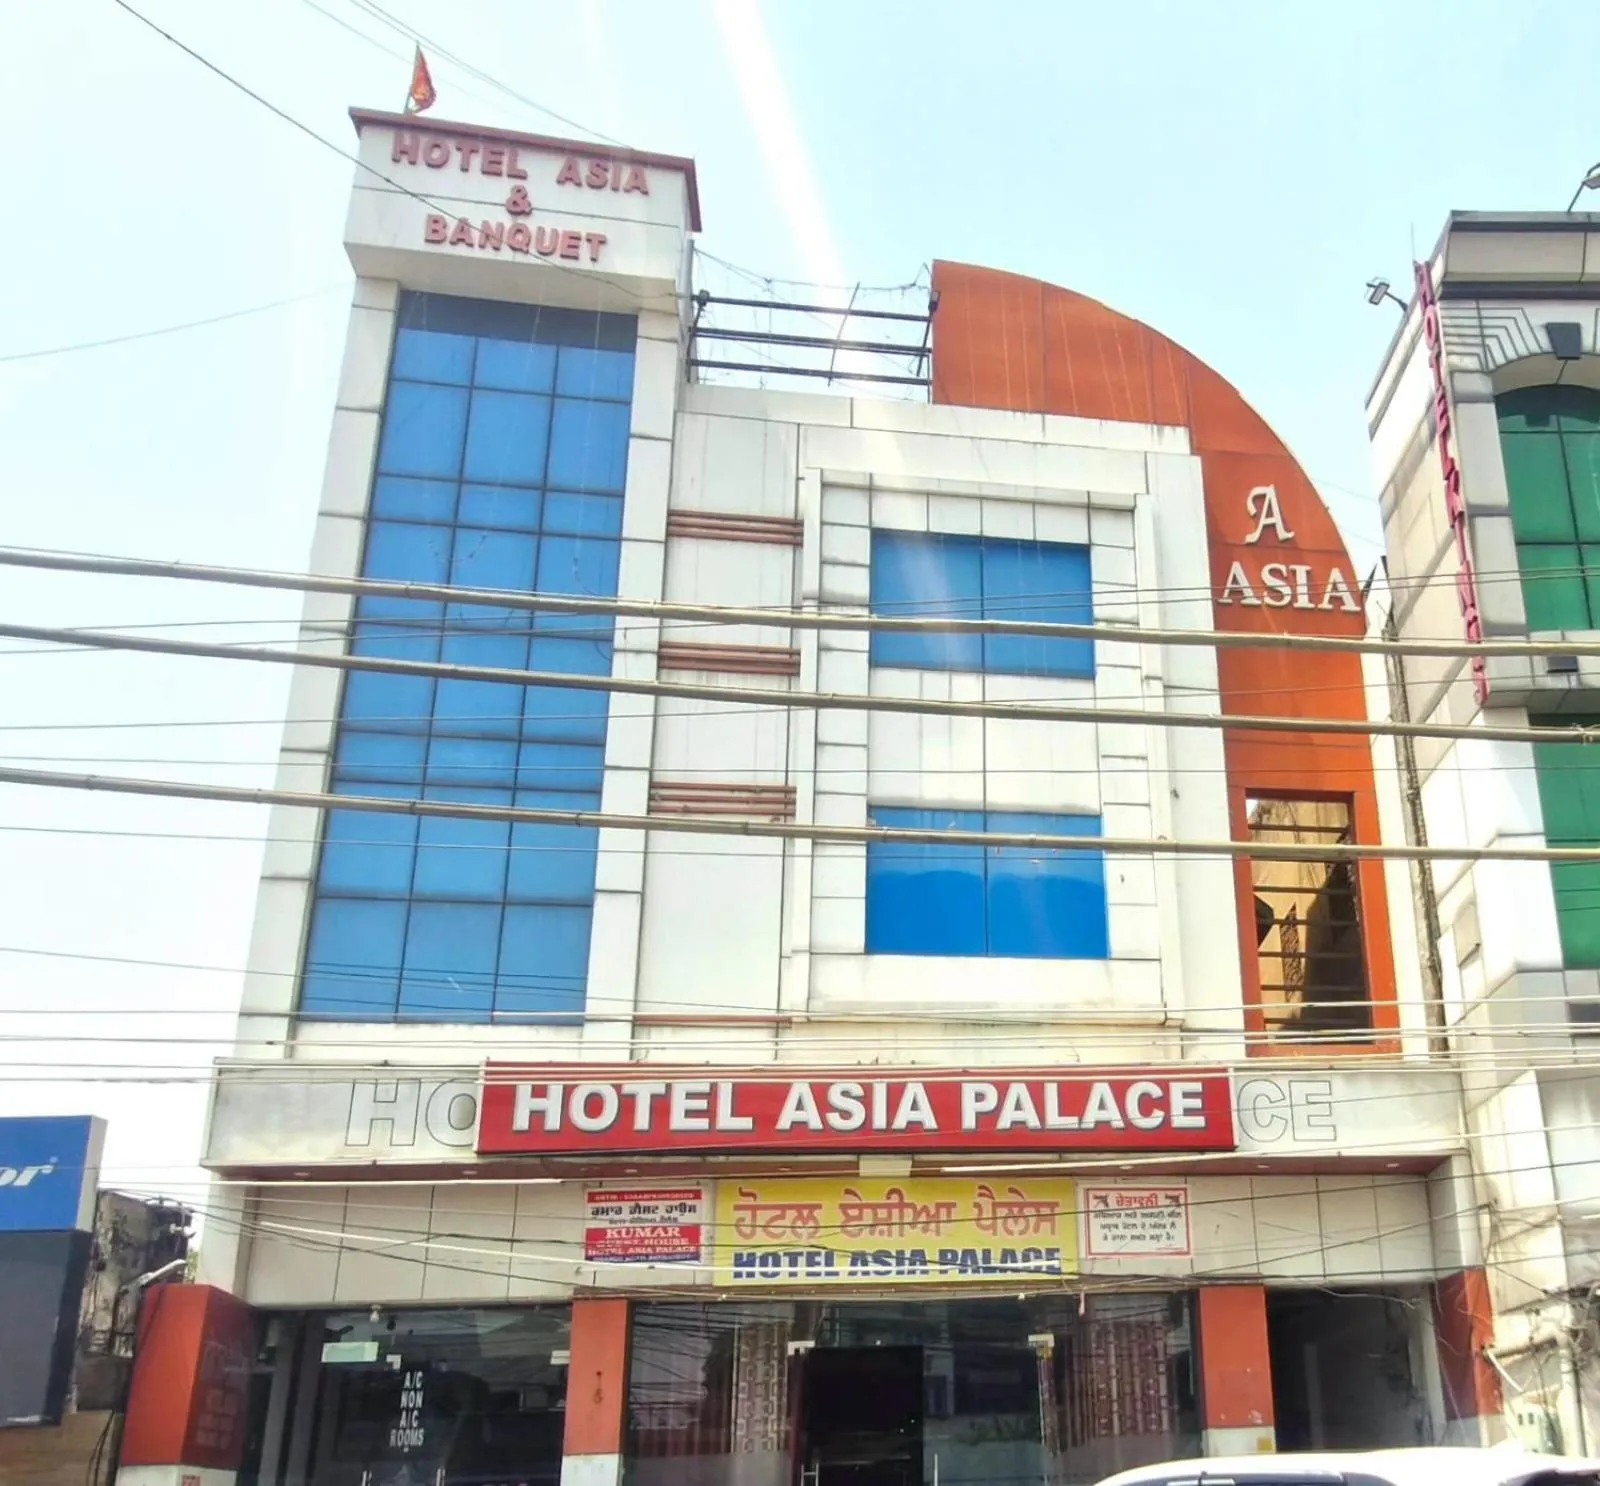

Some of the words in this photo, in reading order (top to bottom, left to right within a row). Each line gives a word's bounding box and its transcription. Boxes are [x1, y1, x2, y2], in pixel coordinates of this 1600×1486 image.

[391, 132, 528, 181] HOTEL
[556, 157, 650, 195] ASIA
[505, 185, 532, 216] &
[424, 214, 608, 263] BANQUET
[1244, 484, 1295, 545] A
[1218, 561, 1361, 612] ASIA
[512, 1081, 754, 1132] HOTEL
[776, 1081, 938, 1131] ASIA
[960, 1081, 1206, 1131] PALACE
[605, 1226, 681, 1239] KUMAR
[733, 1187, 823, 1240] ਹੋਟਲ
[733, 1250, 839, 1279] HOTEL
[848, 1249, 929, 1277] ASIA
[938, 1247, 1062, 1276] PALACE
[400, 1390, 424, 1408] NON
[404, 1370, 423, 1389] A/C
[389, 1428, 424, 1447] ROOMS
